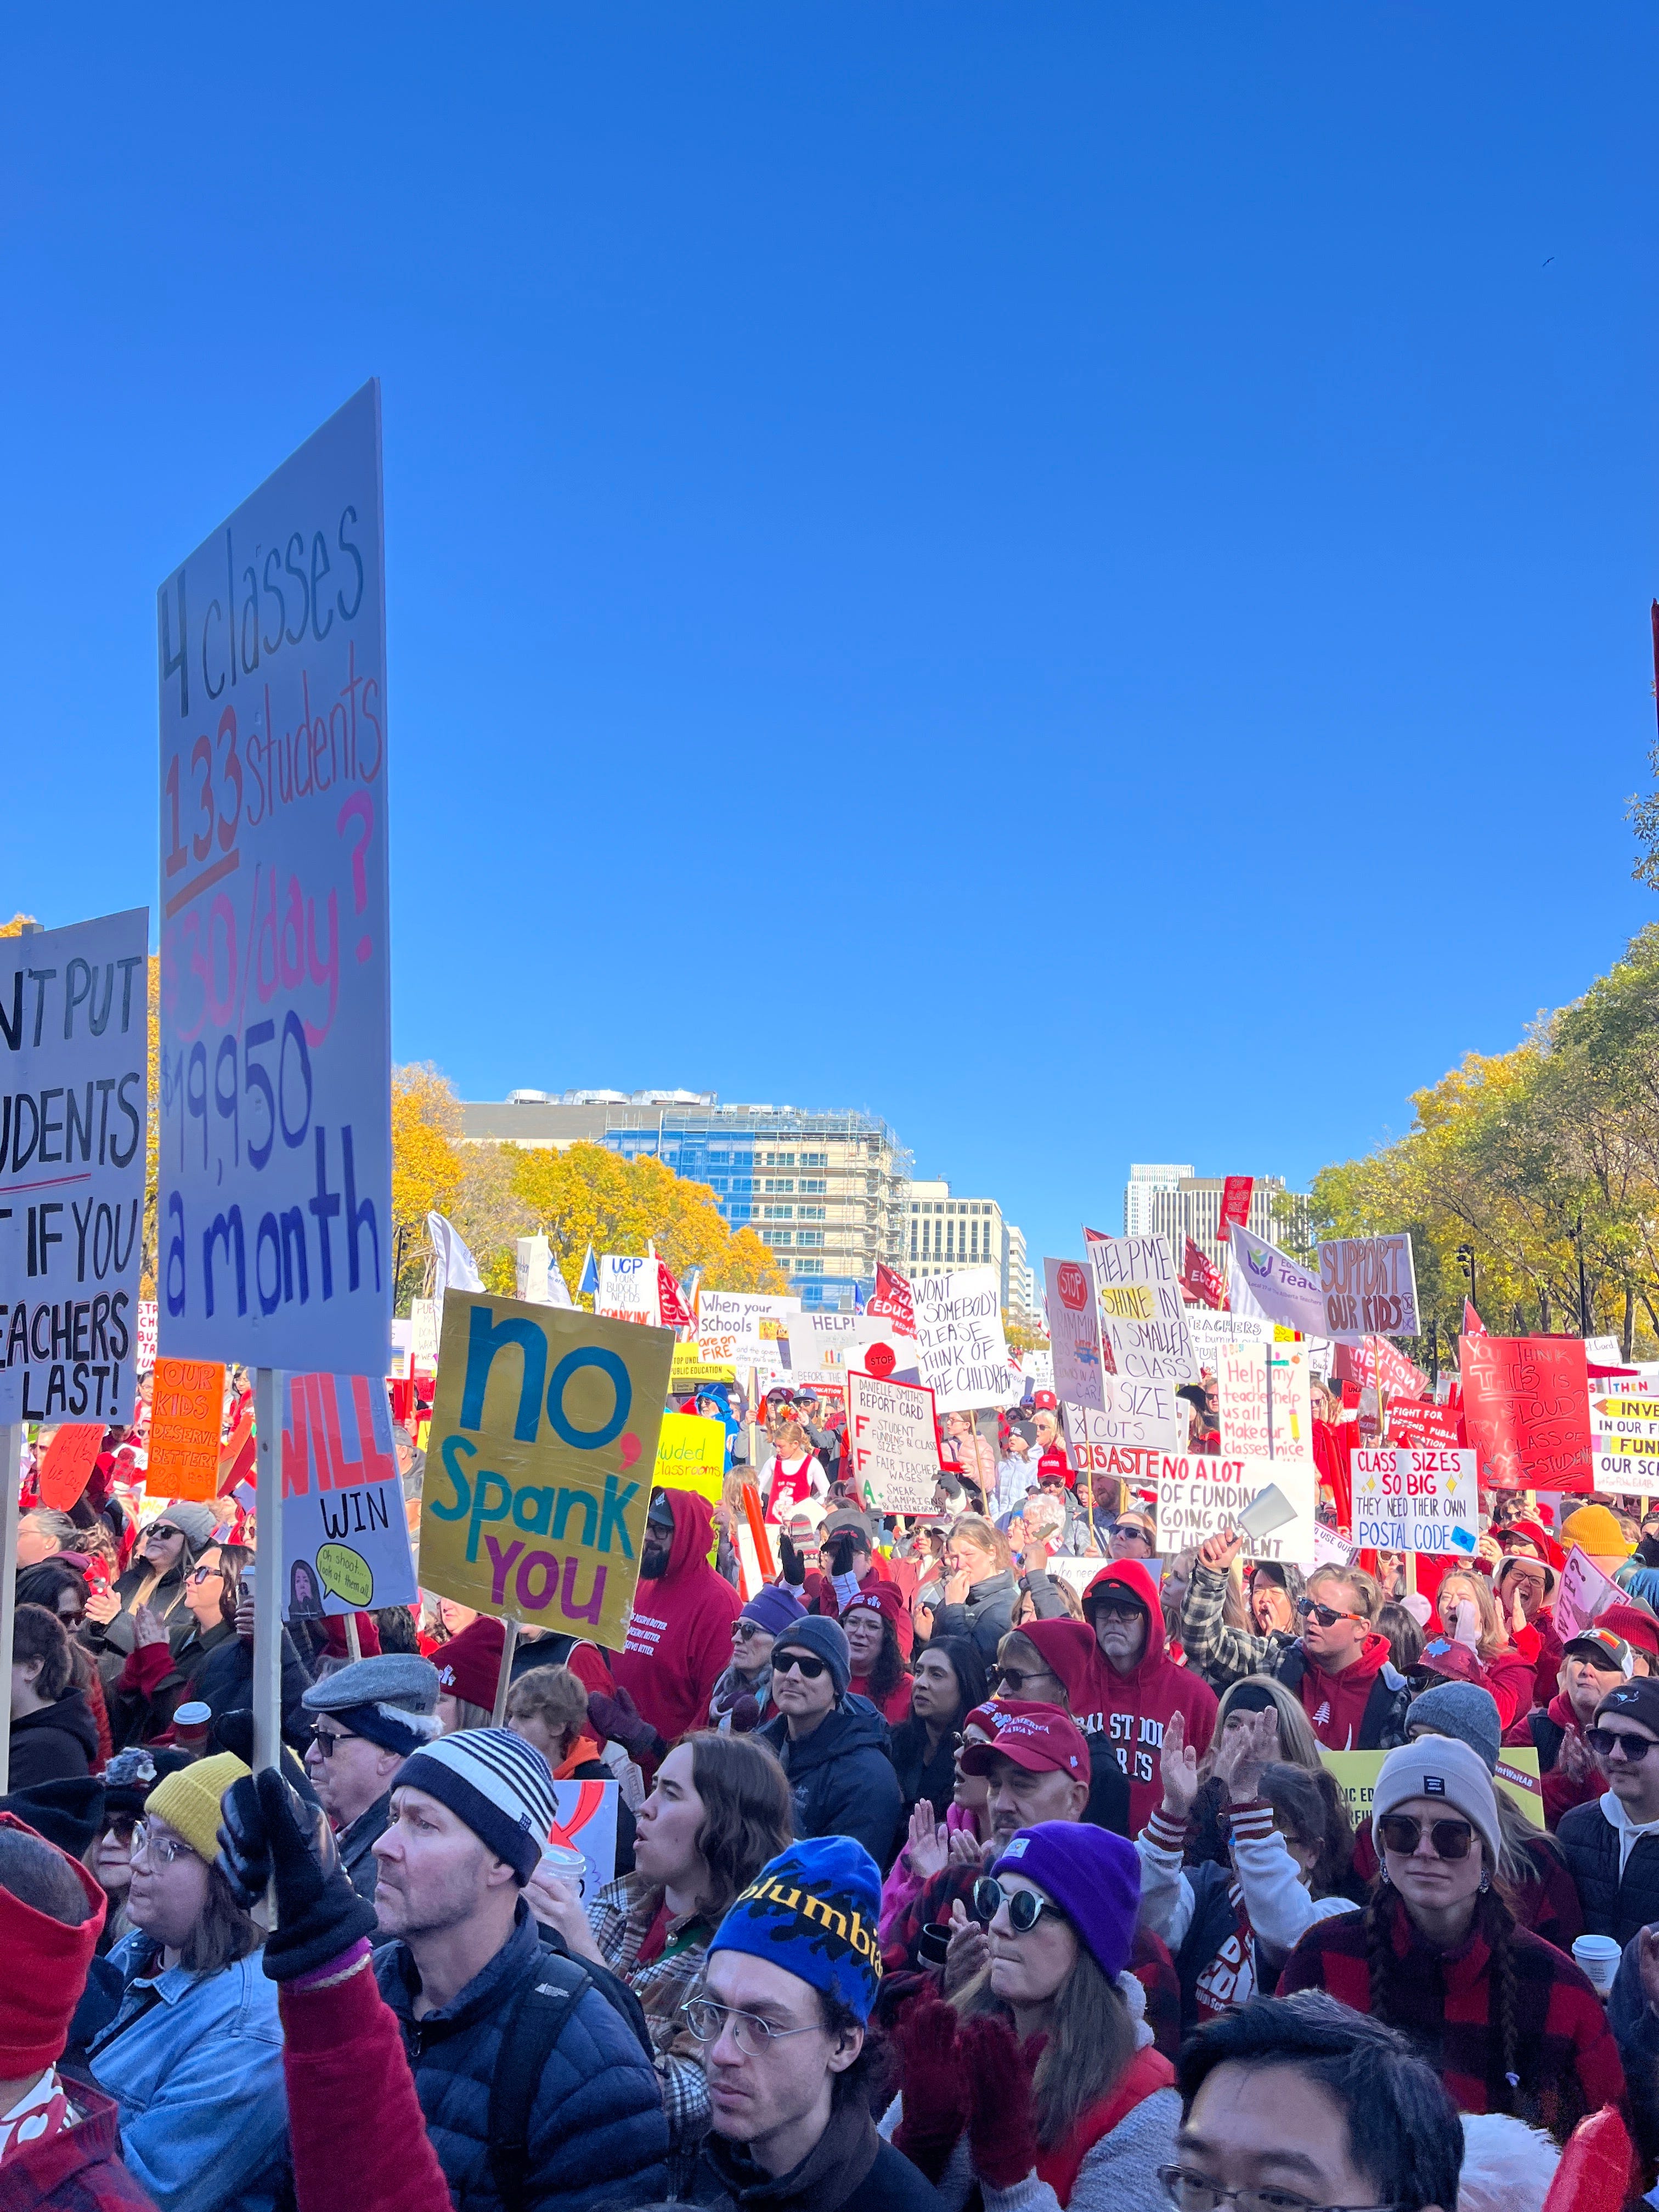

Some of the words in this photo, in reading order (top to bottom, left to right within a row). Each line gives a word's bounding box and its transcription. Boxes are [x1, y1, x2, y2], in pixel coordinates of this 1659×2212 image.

[162, 569, 188, 717] 4
[203, 505, 363, 701] classes
[165, 705, 242, 861] 133
[245, 640, 381, 826] students
[65, 956, 142, 1046] PUT
[1227, 1190, 1249, 1201] CLASS
[1228, 1201, 1244, 1212] SIZE
[27, 1203, 63, 1277] IF
[72, 1199, 137, 1282] YOU
[167, 1191, 185, 1316] a
[1094, 1240, 1141, 1284] HELP
[1142, 1238, 1171, 1280] ME
[612, 1258, 643, 1274] UCP
[1321, 1239, 1403, 1296] SUPPORT
[606, 1283, 639, 1293] BUDGET
[613, 1274, 635, 1284] YOUR
[1060, 1270, 1082, 1300] STOP
[611, 1293, 640, 1301] NEEDS
[702, 1295, 740, 1313] When
[744, 1304, 772, 1315] your
[1102, 1286, 1150, 1319] SHINE
[1159, 1286, 1180, 1319] IN
[1280, 1291, 1297, 1300] Alberta
[923, 1291, 996, 1323] SOMEBODY
[1328, 1295, 1358, 1331] OUR
[1362, 1294, 1402, 1332] KIDS
[812, 1316, 855, 1331] HELP!
[698, 1337, 718, 1347] are
[720, 1335, 737, 1344] on
[918, 1321, 990, 1347] PLEASE
[1113, 1324, 1122, 1350] A
[1127, 1321, 1192, 1358] SMALLER
[702, 1345, 732, 1361] FIRE
[1594, 1339, 1613, 1351] Card
[871, 1356, 893, 1365] STOP
[921, 1345, 964, 1373] THINK
[971, 1339, 994, 1361] OF
[165, 1362, 215, 1391] OUR
[691, 1366, 722, 1374] EDUCATION
[1080, 1369, 1086, 1381] IN
[1089, 1370, 1096, 1384] A
[1125, 1354, 1192, 1379] CLASS
[1228, 1361, 1265, 1386] Help
[1272, 1369, 1294, 1387] my
[798, 1372, 824, 1381] BEFORE
[829, 1372, 841, 1383] THE
[926, 1373, 959, 1395] THE
[962, 1364, 1010, 1394] CHILDREN
[1470, 1364, 1540, 1391] THIS
[1553, 1373, 1570, 1388] IS
[1613, 1381, 1647, 1392] THEN
[22, 1361, 119, 1420] LAST!
[459, 1305, 642, 1471] no,
[859, 1380, 893, 1397] DANIELLE
[1076, 1383, 1101, 1402] CAR!
[1276, 1388, 1300, 1408] help
[154, 1392, 208, 1419] KIDS
[860, 1393, 896, 1413] REPORT
[899, 1402, 923, 1420] CARD
[1120, 1382, 1170, 1421] SIZE
[1222, 1407, 1238, 1420] us
[1393, 1407, 1420, 1419] FIGHT
[1424, 1409, 1443, 1421] FOR
[153, 1423, 218, 1448] DESERVE
[856, 1415, 870, 1437] F
[878, 1420, 915, 1437] STUDENT
[1075, 1418, 1086, 1435] X
[1094, 1416, 1145, 1440] CUTS
[1226, 1424, 1258, 1440] Make
[1430, 1426, 1458, 1441] PUBLIC
[1469, 1419, 1499, 1439] TRY
[1599, 1420, 1612, 1431] IN
[1617, 1421, 1641, 1433] OUR
[872, 1430, 905, 1446] FUNDING
[907, 1438, 912, 1446] &
[915, 1438, 937, 1450] CLASS
[877, 1442, 902, 1454] SIZES
[1224, 1441, 1269, 1456] classes
[1276, 1441, 1304, 1455] nice
[1504, 1431, 1562, 1454] CLASS
[1565, 1432, 1584, 1442] OF
[150, 1446, 217, 1470] BETTER!
[857, 1449, 871, 1471] F
[876, 1455, 895, 1471] FAIR
[899, 1462, 938, 1474] TEACHER
[1358, 1452, 1396, 1472] CLASS
[1413, 1452, 1461, 1472] SIZES
[1601, 1457, 1631, 1474] OUR
[889, 1470, 922, 1483] WAGES
[1163, 1456, 1188, 1480] NO
[1195, 1459, 1206, 1480] A
[1212, 1460, 1245, 1482] LOT
[887, 1483, 916, 1496] SMEAR
[1160, 1484, 1182, 1503] OF
[1382, 1474, 1403, 1495] SO
[1407, 1475, 1436, 1495] BIG
[882, 1502, 889, 1510] &
[888, 1495, 943, 1506] CAMPAIGNS
[1356, 1497, 1381, 1515] THEY
[1387, 1498, 1408, 1517] NEED
[1412, 1498, 1440, 1516] THEIR
[1443, 1499, 1466, 1517] OWN
[320, 1487, 388, 1539] WIN
[1160, 1505, 1212, 1529] GOING
[1321, 1531, 1336, 1545] USE
[1359, 1521, 1412, 1550] POSTAL
[1414, 1524, 1450, 1550] CODE
[1048, 1561, 1071, 1578] Who
[334, 1571, 341, 1583] at
[345, 1575, 359, 1590] them
[1009, 1718, 1049, 1734] AMERICA
